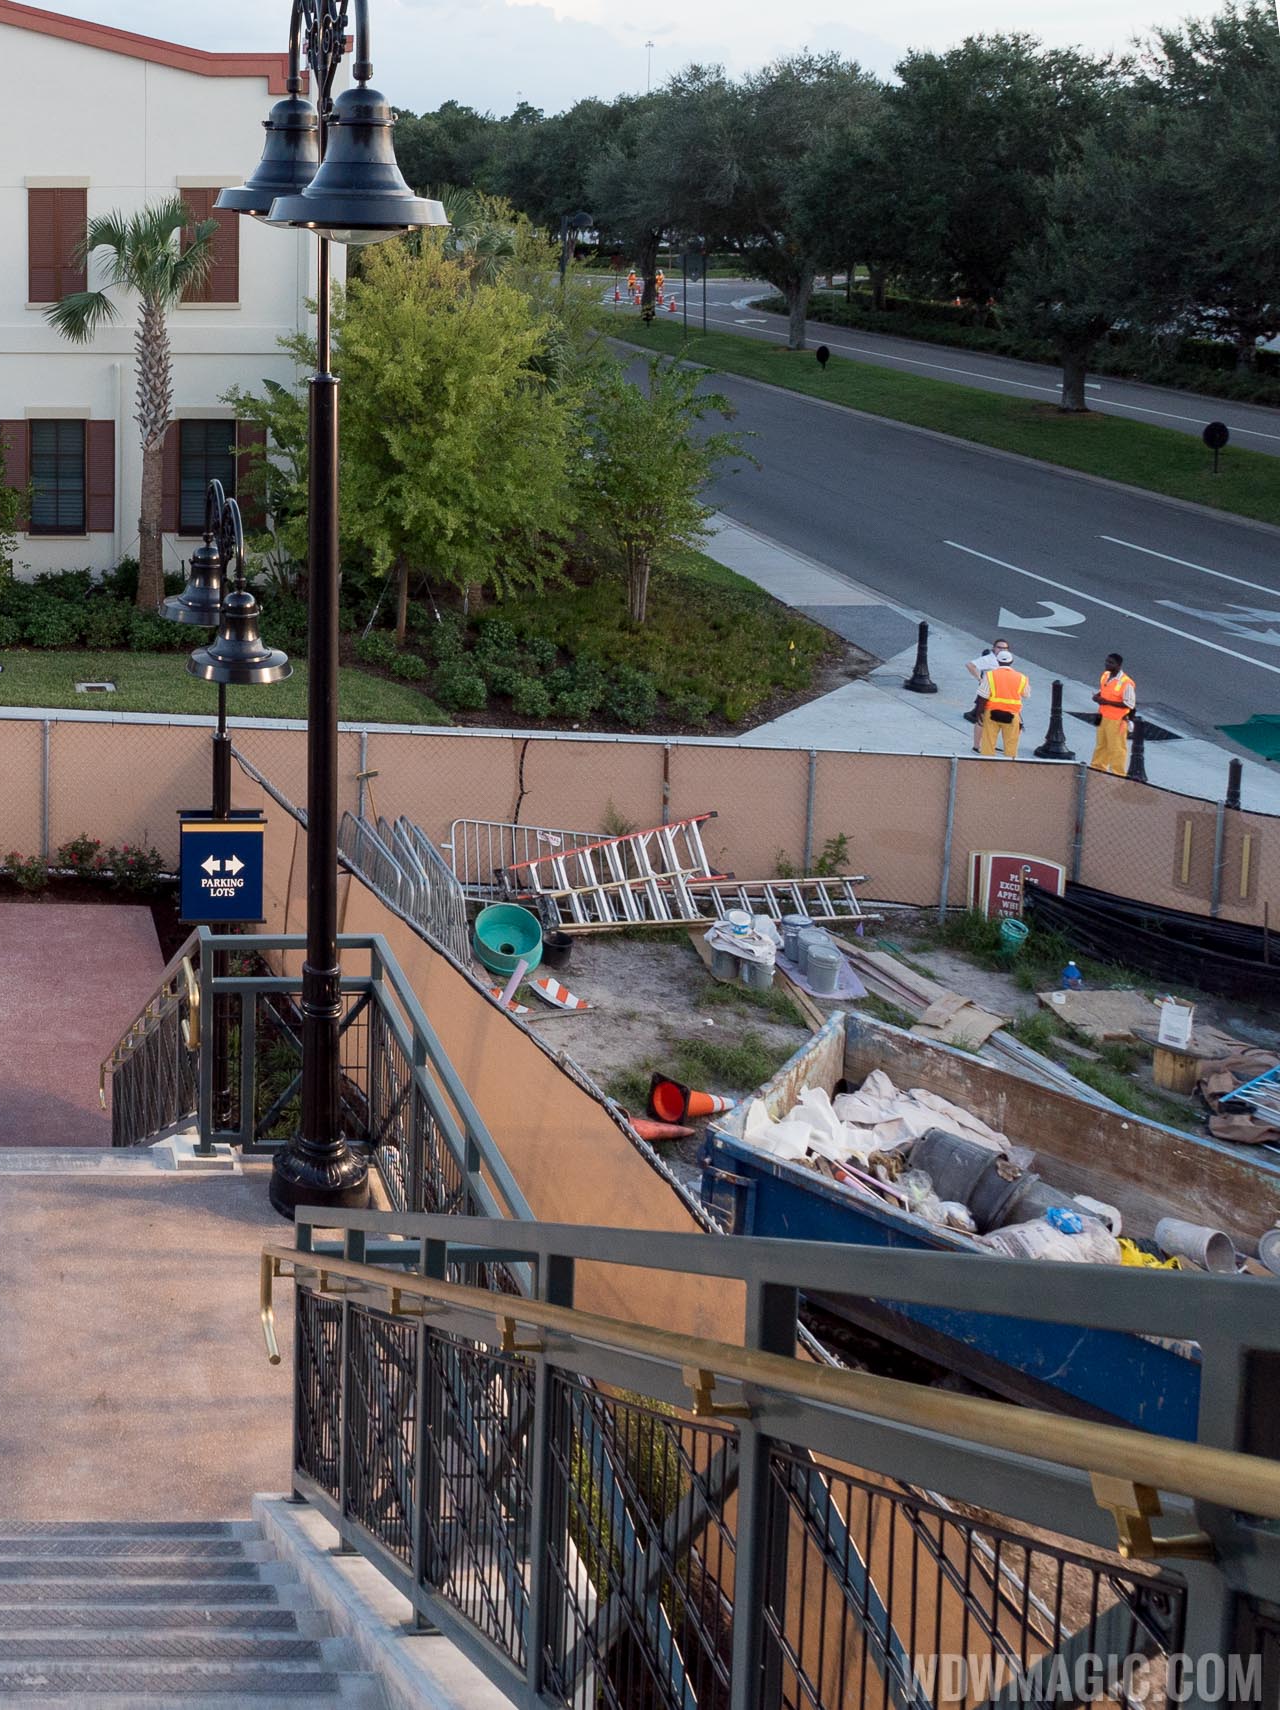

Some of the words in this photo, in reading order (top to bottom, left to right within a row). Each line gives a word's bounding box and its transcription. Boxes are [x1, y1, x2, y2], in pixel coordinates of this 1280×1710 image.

[201, 878, 244, 888] PARKING
[999, 881, 1020, 892] EXCU
[210, 888, 235, 897] LOTS
